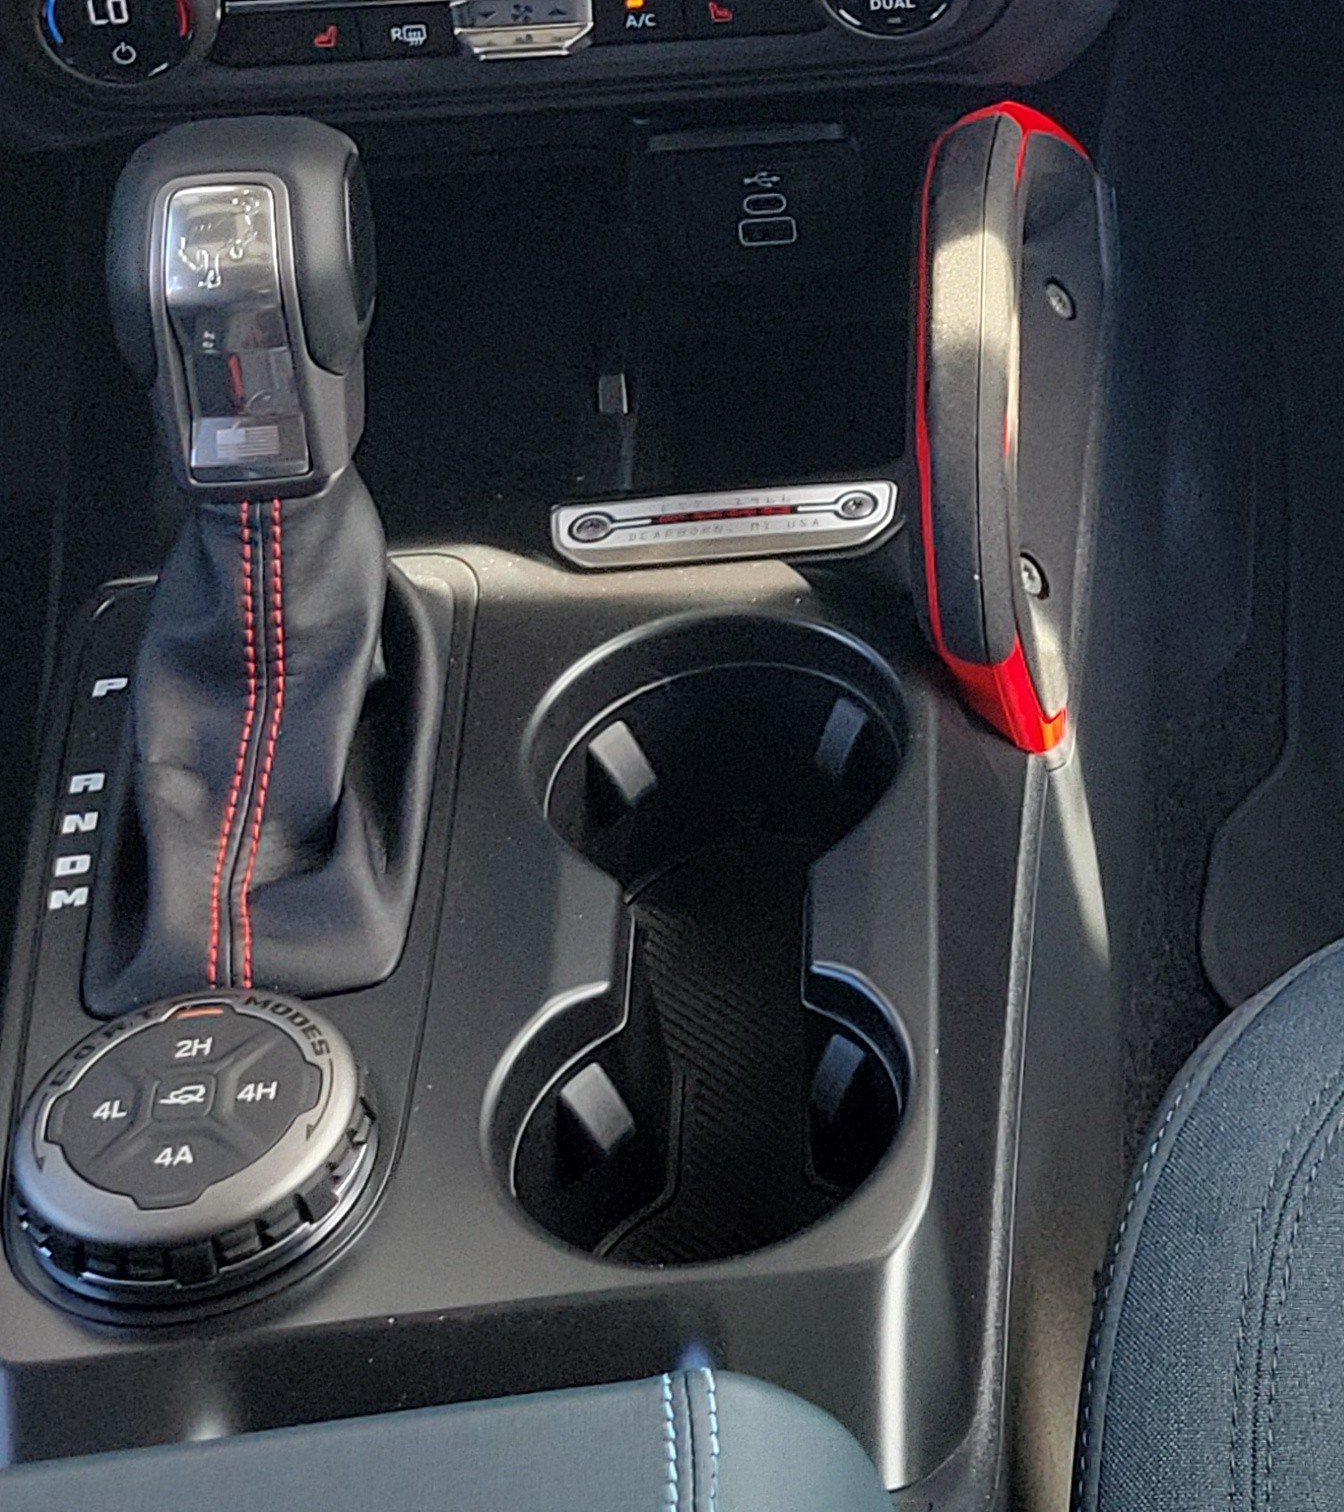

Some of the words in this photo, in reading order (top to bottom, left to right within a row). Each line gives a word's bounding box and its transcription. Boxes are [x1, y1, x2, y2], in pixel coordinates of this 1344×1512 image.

[625, 12, 656, 28] A/C
[787, 519, 820, 530] USA
[92, 677, 128, 697] P
[61, 811, 98, 834] N
[54, 854, 91, 877] D
[48, 887, 89, 910] M
[244, 995, 332, 1057] MODES
[175, 1036, 213, 1058] 2H
[236, 1081, 278, 1102] 4H
[92, 1100, 127, 1120] 4L
[154, 1144, 195, 1167] 4A
